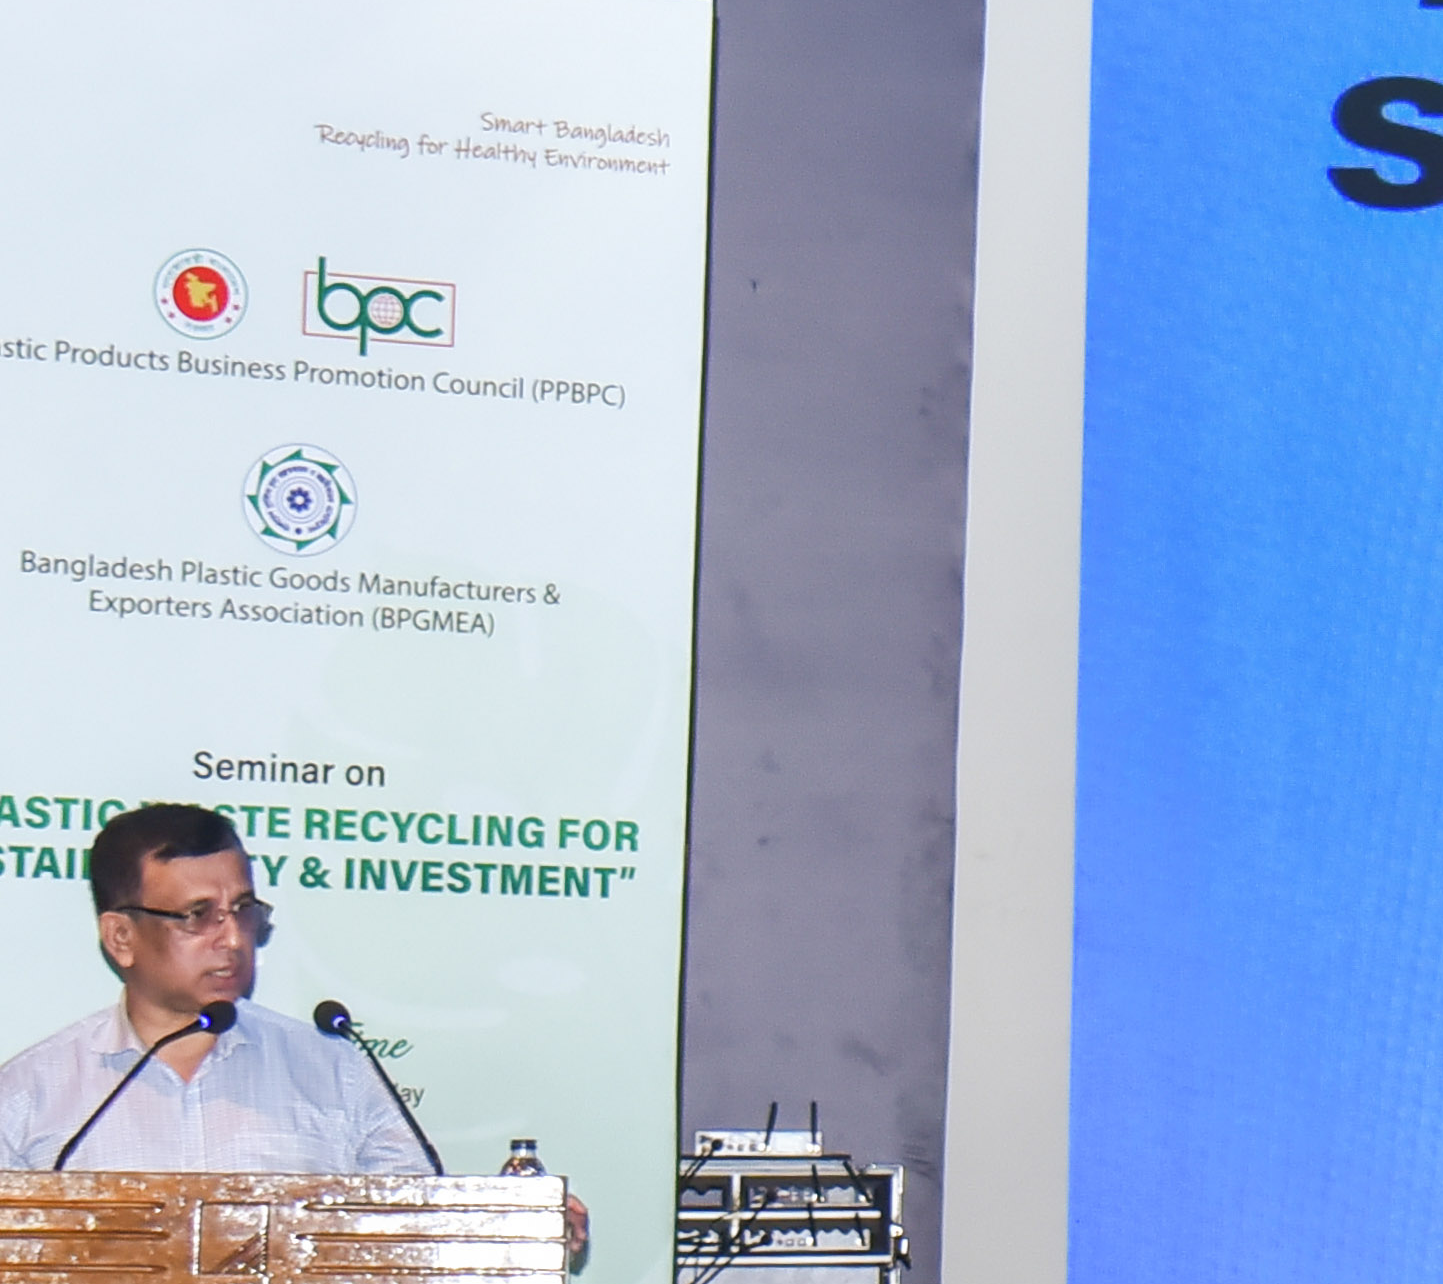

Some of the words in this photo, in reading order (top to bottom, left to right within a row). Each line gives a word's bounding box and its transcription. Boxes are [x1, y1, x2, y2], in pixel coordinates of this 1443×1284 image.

[314, 125, 409, 159] Recycling
[417, 134, 448, 155] for
[454, 137, 536, 168] Healthy
[544, 149, 670, 174] Environment
[481, 112, 547, 135] Smart
[553, 121, 669, 149] Bangladesh
[4, 339, 46, 361] stic
[55, 341, 169, 371] Products
[178, 351, 285, 380] Business
[294, 361, 425, 391] Promotion
[433, 372, 523, 398] Council
[532, 380, 625, 409] (PPBPC)
[21, 551, 172, 582] Bangladesh
[182, 561, 261, 587] Plastic
[269, 567, 350, 592] Goods
[359, 573, 536, 603] Manufacturers
[543, 584, 560, 604] &
[90, 590, 212, 618] Exporters
[220, 599, 363, 627] Association
[373, 607, 494, 637] (BPGMEA)
[194, 752, 334, 784] Seminar
[346, 765, 384, 786] on
[305, 809, 544, 848] RECYCLING
[559, 819, 638, 851] FOR
[300, 857, 330, 888] &
[345, 859, 635, 898] INVESTMENT”
